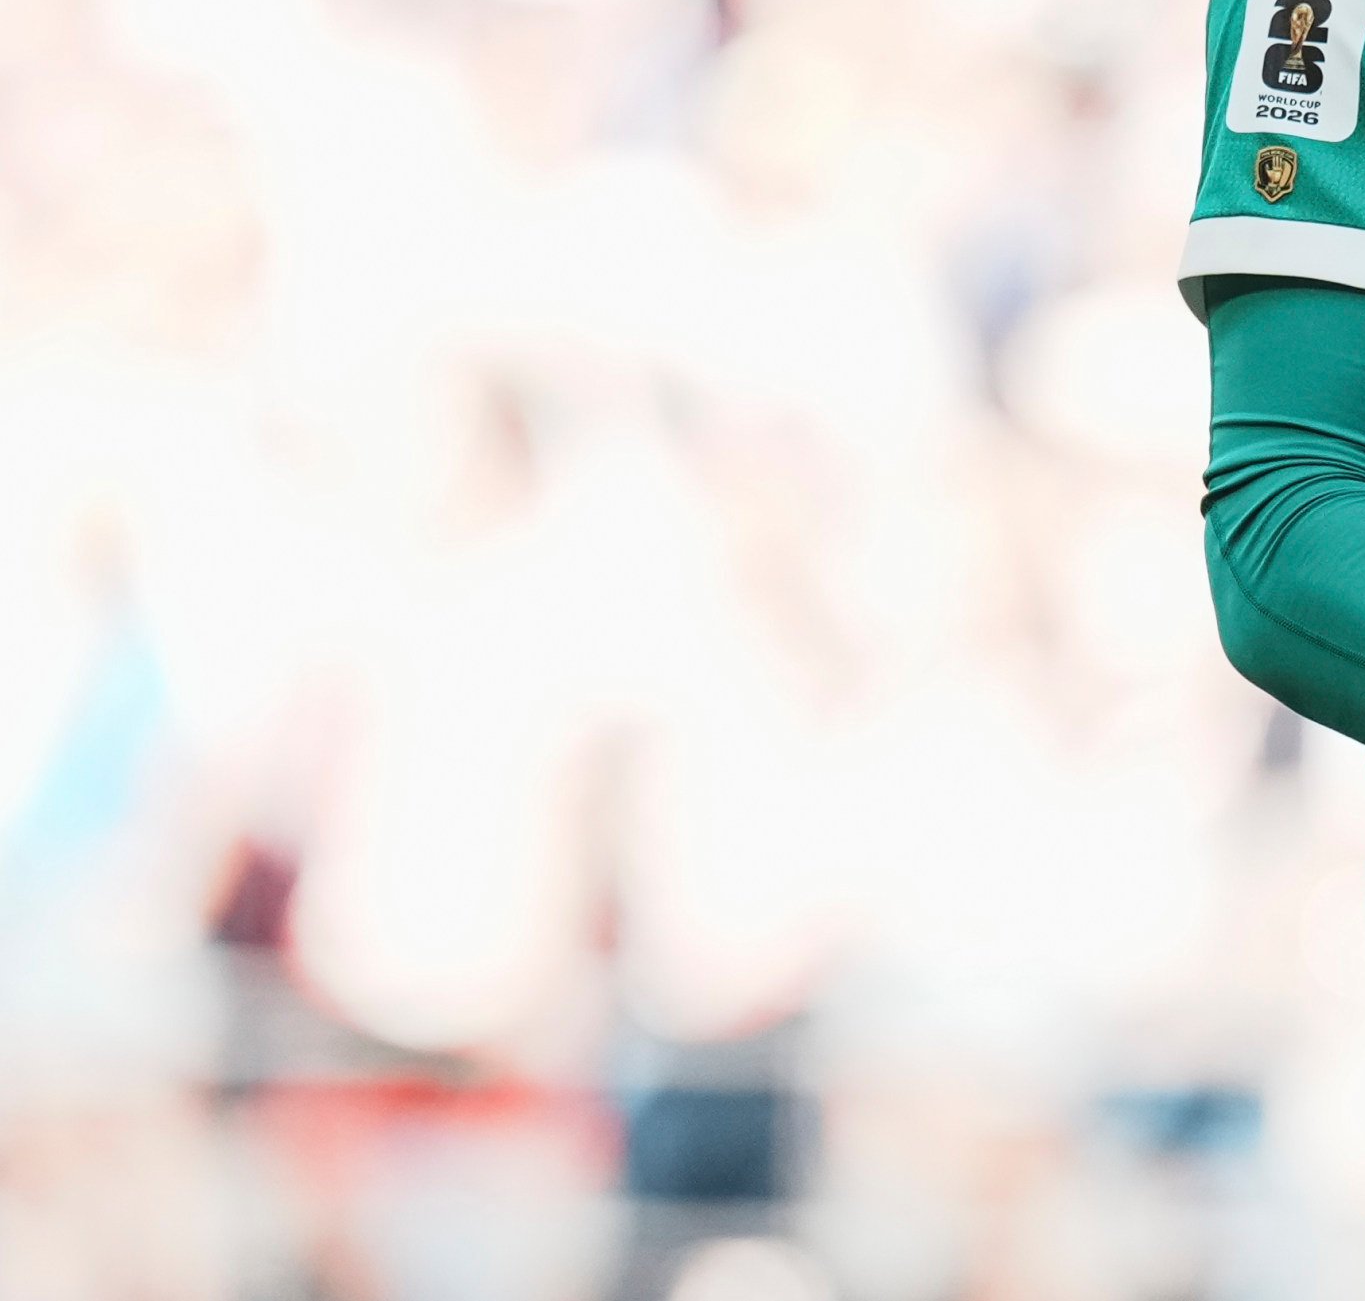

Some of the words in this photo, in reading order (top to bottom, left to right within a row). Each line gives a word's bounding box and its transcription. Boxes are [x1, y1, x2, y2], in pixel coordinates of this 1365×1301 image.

[1278, 71, 1308, 86] FIFA
[1258, 94, 1298, 107] WORLD
[1299, 100, 1322, 109] CUP
[1256, 104, 1319, 125] 2026
